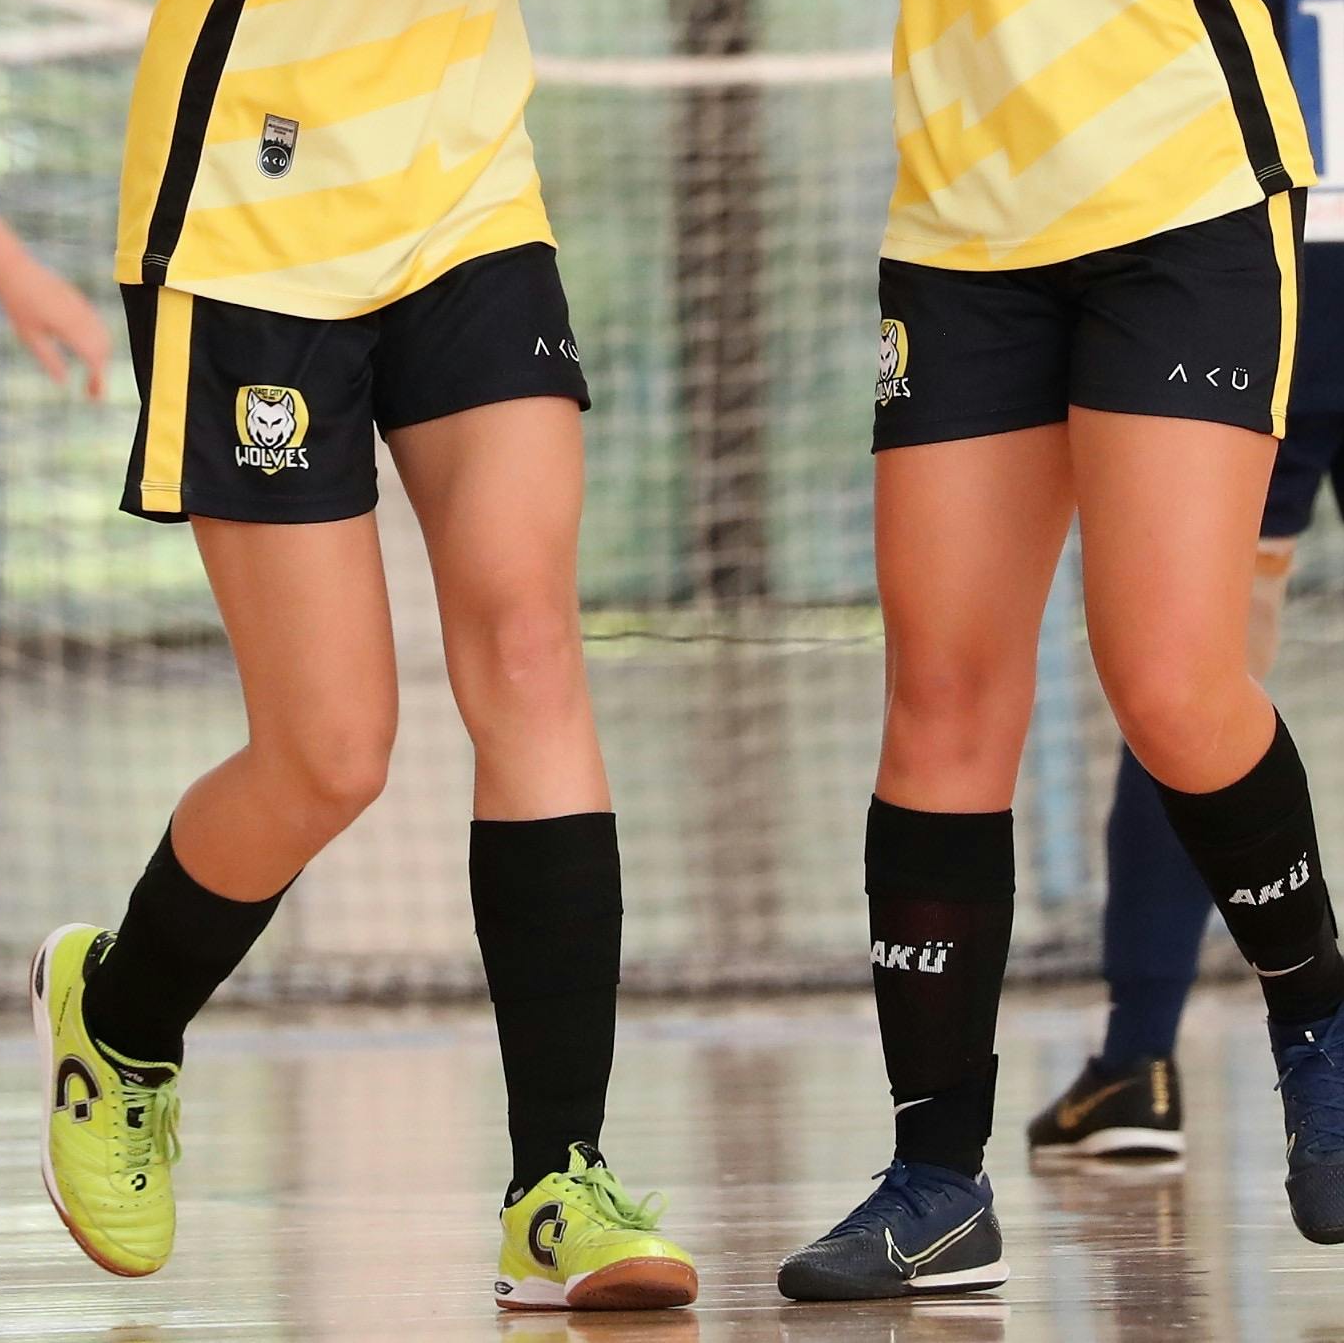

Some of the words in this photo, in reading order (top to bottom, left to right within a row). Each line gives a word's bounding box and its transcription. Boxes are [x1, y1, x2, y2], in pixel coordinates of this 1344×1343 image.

[235, 445, 309, 470] WOLVES
[1228, 851, 1310, 905] AKÜ
[870, 940, 954, 974] AKÜ
